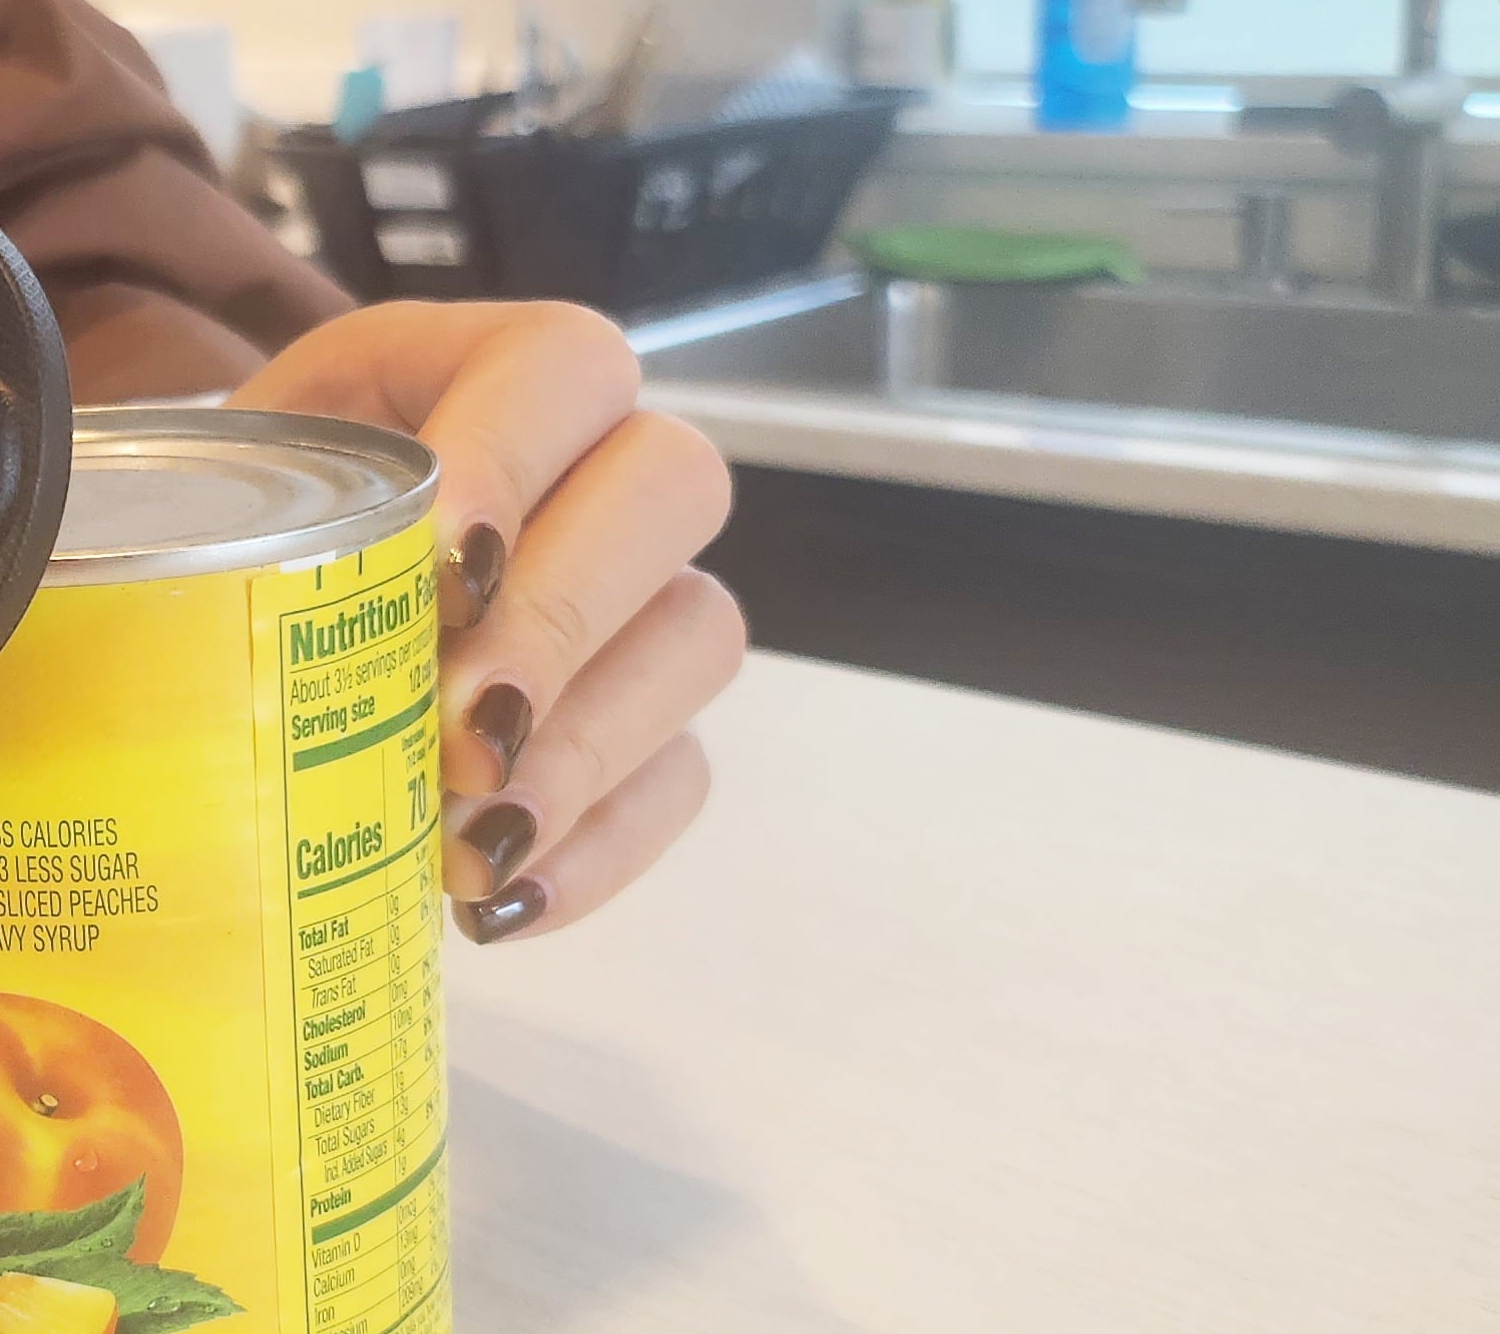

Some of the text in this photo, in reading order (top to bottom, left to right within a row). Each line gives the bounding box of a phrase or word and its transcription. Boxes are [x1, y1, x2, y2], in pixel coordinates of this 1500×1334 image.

[290, 591, 410, 665] Nutrition
[290, 670, 331, 707] About
[354, 649, 396, 687] servings
[291, 695, 375, 741] Serving size
[407, 770, 426, 831] 70
[21, 818, 118, 848] CALORIES
[296, 820, 382, 880] Calories
[15, 855, 63, 883] LESS
[70, 852, 139, 883] SUGAR
[70, 885, 159, 917] PEACHES
[33, 924, 100, 952] SYRUP
[299, 918, 349, 951] Total Fat
[308, 938, 375, 979] Saturated Fat
[311, 977, 357, 1008] Trans Fat
[303, 1000, 366, 1041] Cholesterol
[304, 1042, 349, 1071] Sodium
[306, 1075, 333, 1101] Total
[315, 1087, 375, 1128] Dietary Fiber
[316, 1116, 375, 1156] Total Sugars
[310, 1189, 351, 1217] Protein
[311, 1232, 361, 1268] Vitamin D
[314, 1267, 355, 1298] Calcium
[314, 1304, 335, 1326] Iron
